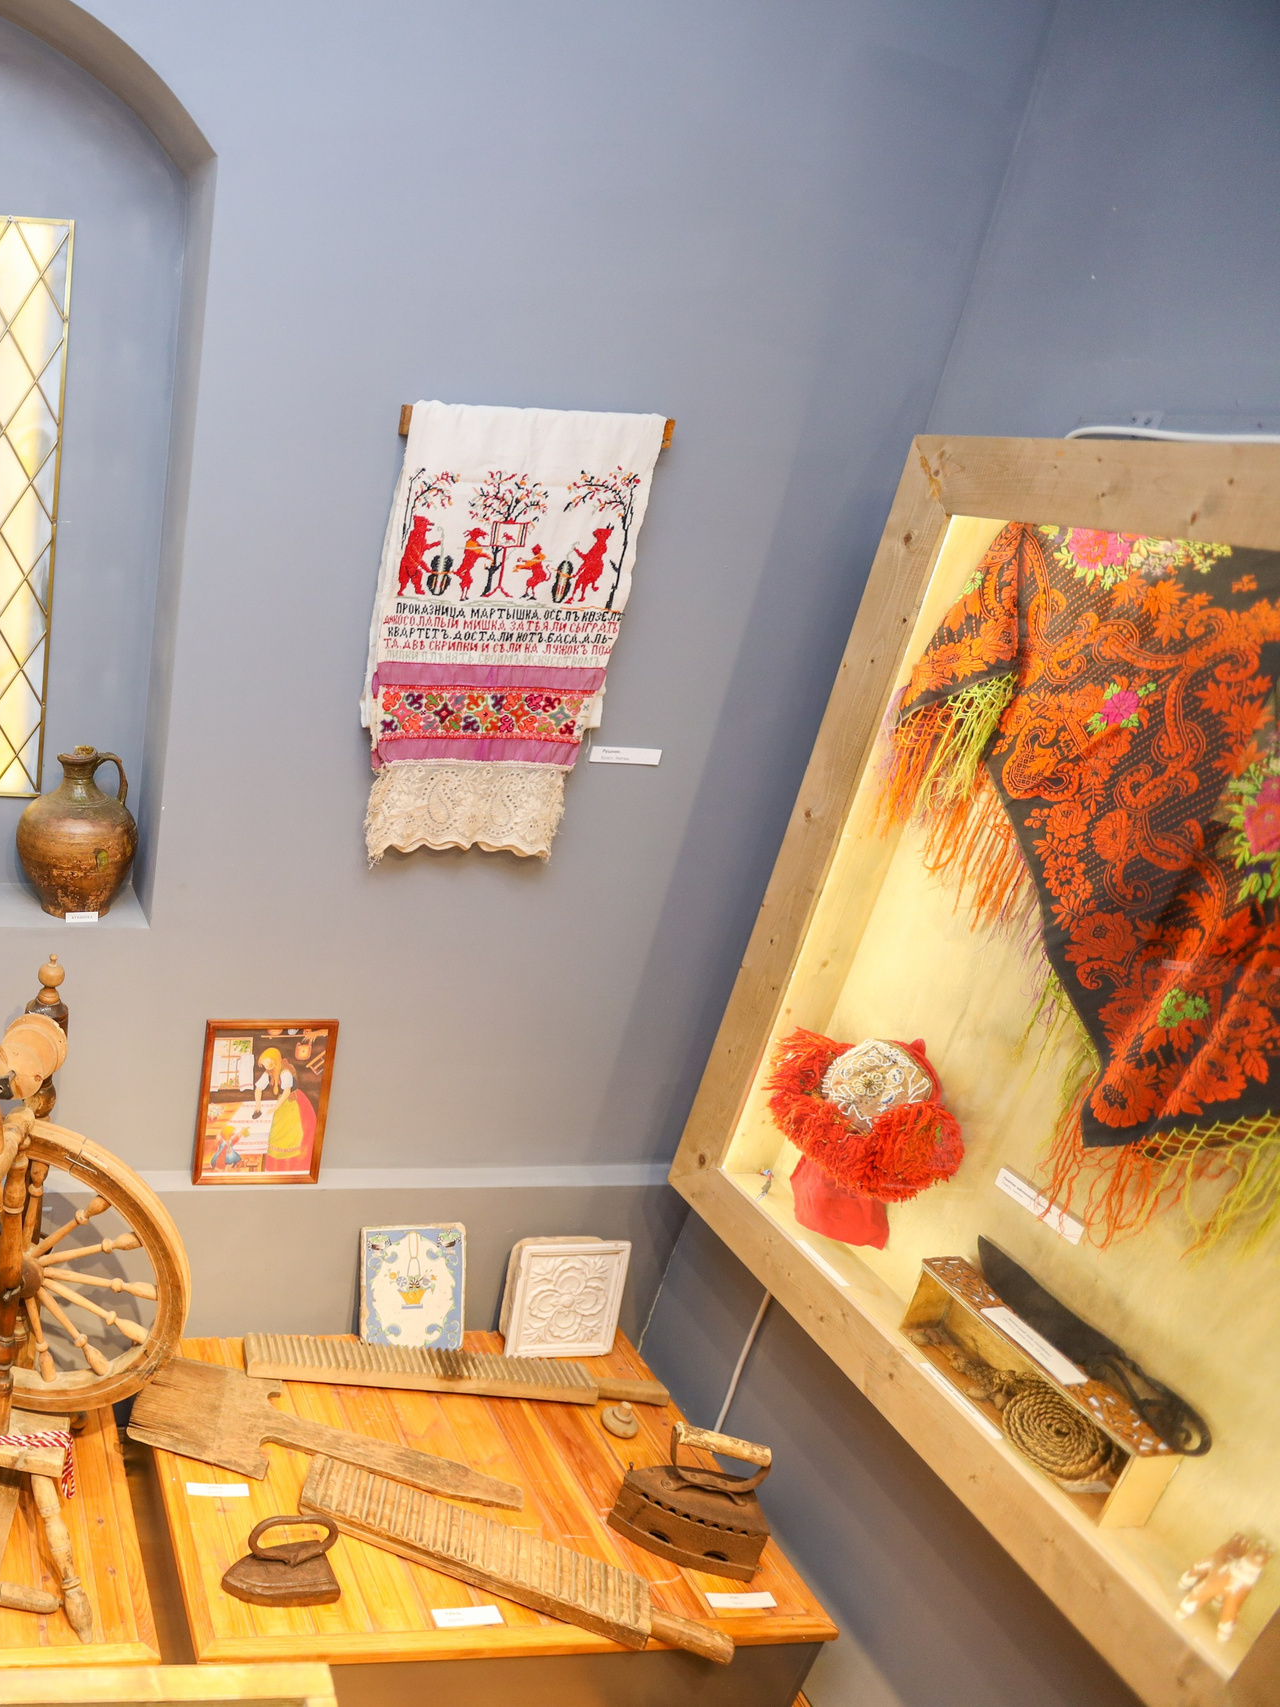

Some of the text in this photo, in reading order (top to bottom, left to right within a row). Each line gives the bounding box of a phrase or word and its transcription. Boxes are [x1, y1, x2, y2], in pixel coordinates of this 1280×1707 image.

[396, 602, 466, 619] ПРОКАЗНИЦА
[463, 619, 506, 632] МИШКА
[429, 640, 478, 652] СКРИПКИ
[481, 643, 490, 653] И
[524, 643, 538, 654] НА
